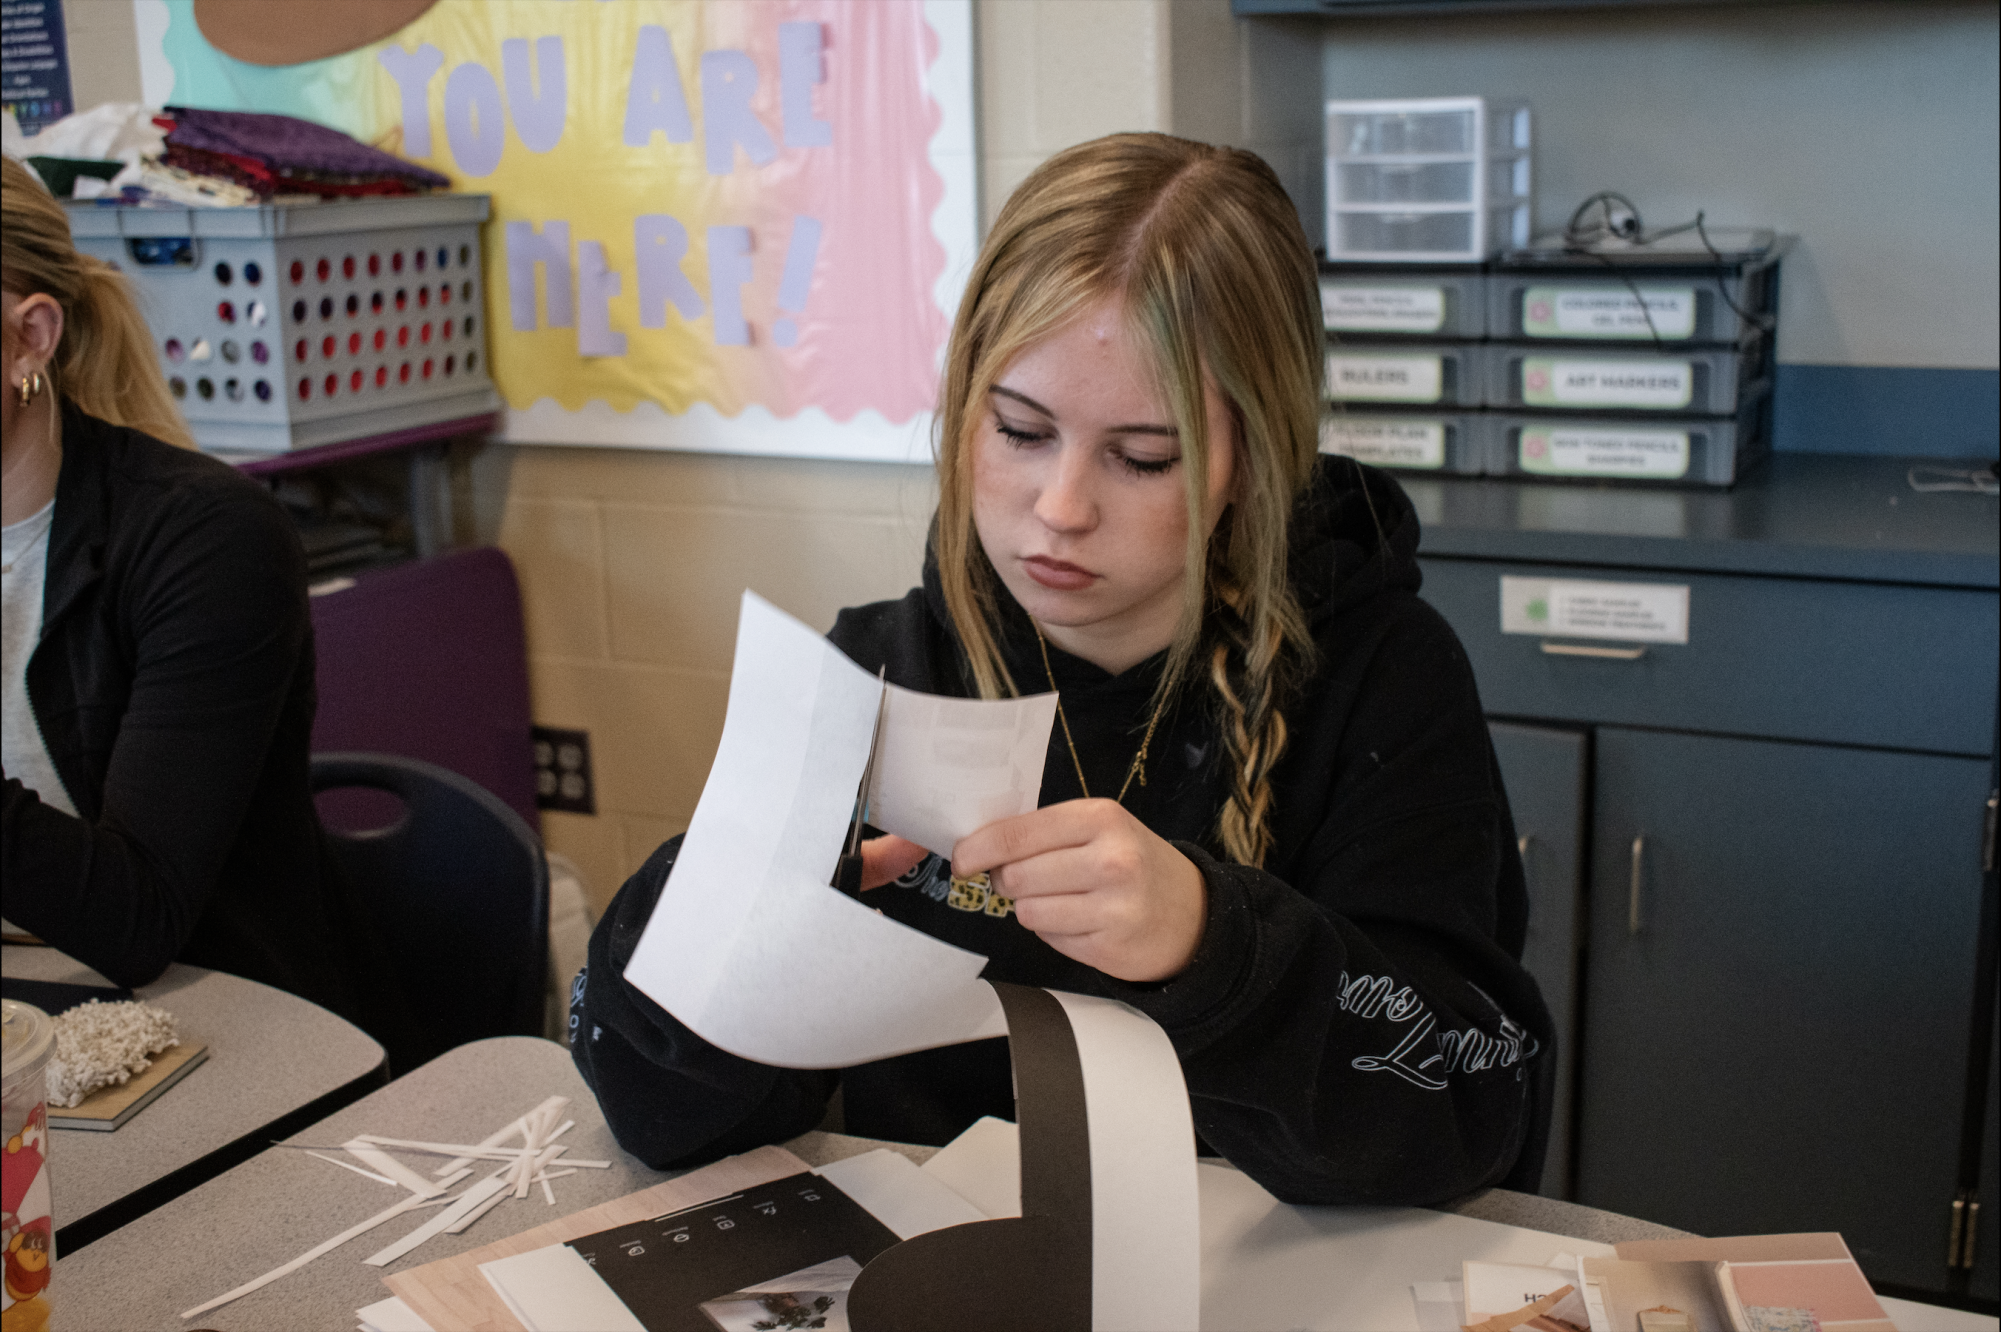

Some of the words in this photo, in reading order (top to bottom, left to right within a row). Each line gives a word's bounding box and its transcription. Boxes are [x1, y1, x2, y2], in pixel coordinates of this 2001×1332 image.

[377, 35, 567, 177] YOU
[622, 21, 833, 176] ARE
[505, 213, 823, 357] HERE!
[1341, 368, 1409, 385] RULERS
[1565, 374, 1597, 389] ART
[1601, 375, 1681, 391] MARKERS
